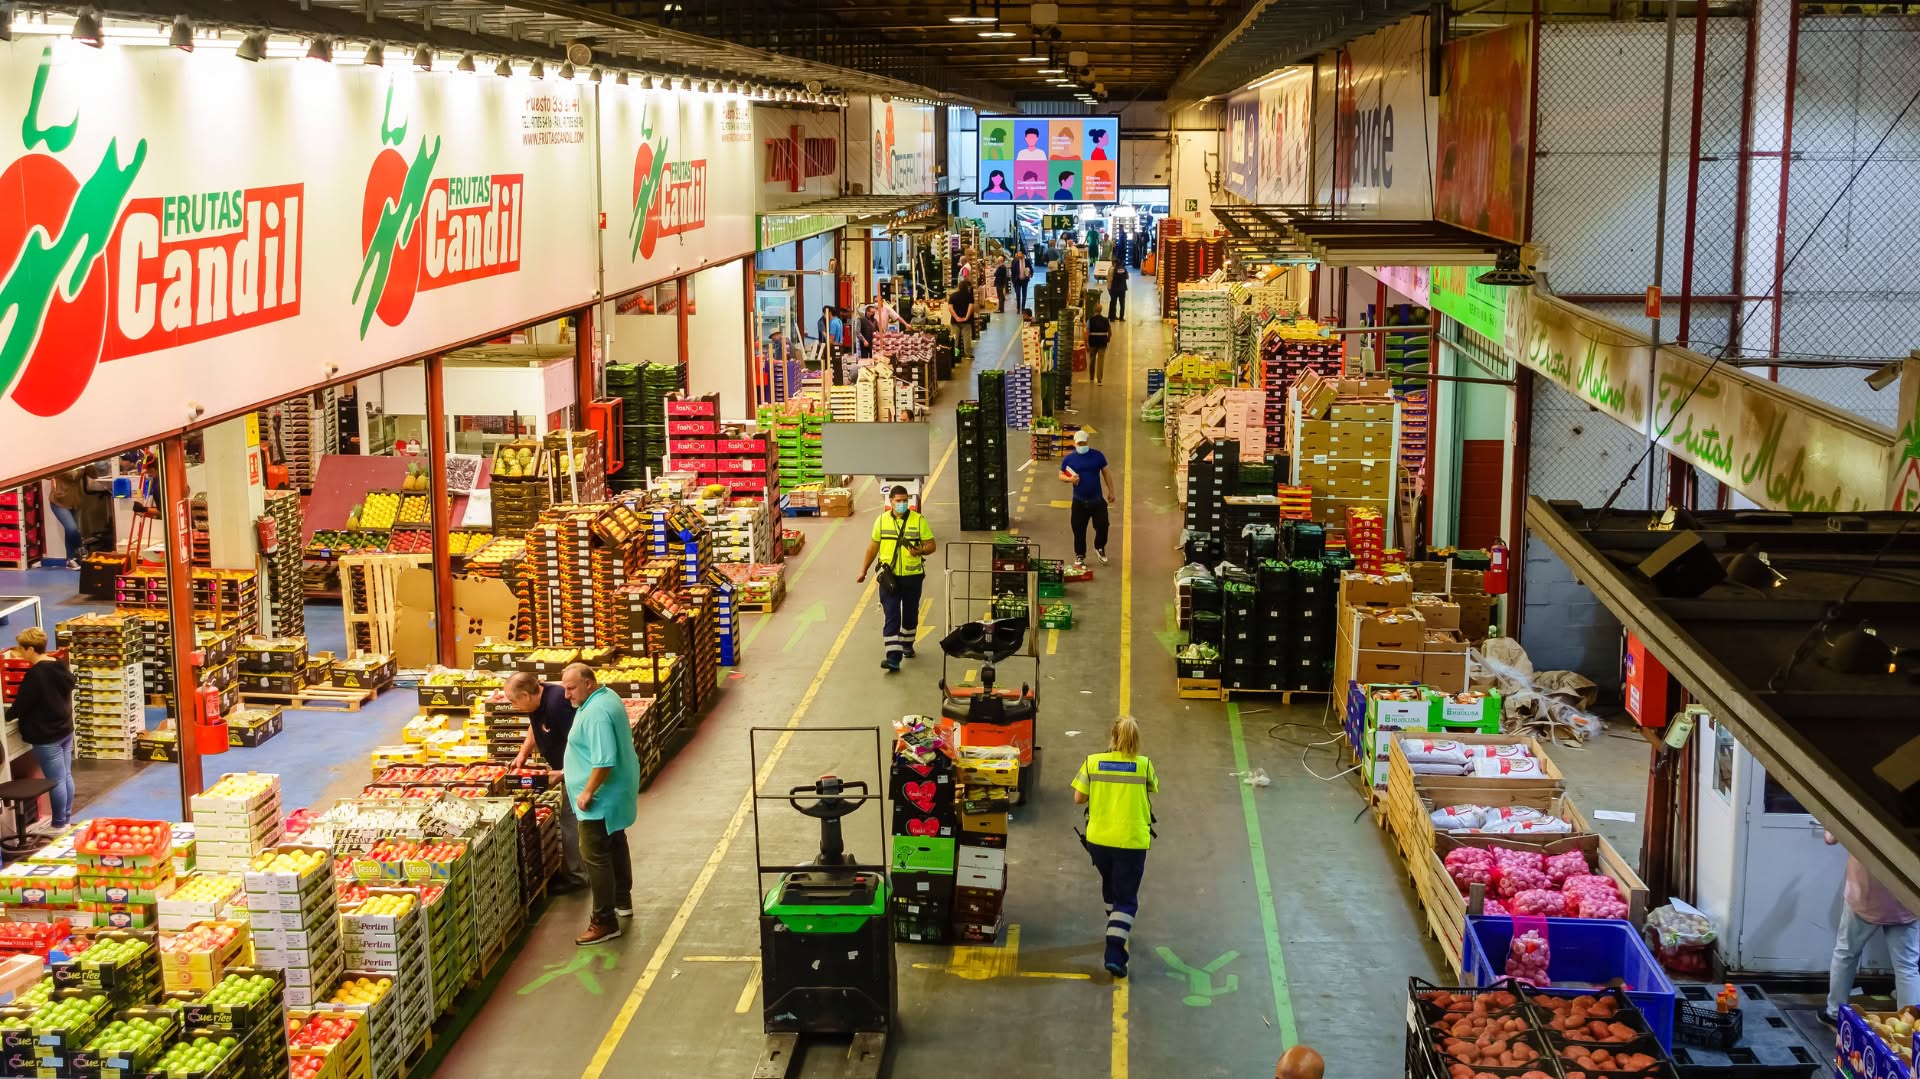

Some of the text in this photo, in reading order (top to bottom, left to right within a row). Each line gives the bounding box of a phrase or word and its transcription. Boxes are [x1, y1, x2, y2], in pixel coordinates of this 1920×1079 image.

[671, 162, 691, 181] FRUTAS
[448, 176, 490, 206] FRUTAS
[661, 166, 705, 230] Candil
[164, 190, 244, 237] FRUTAS
[426, 184, 520, 278] Candil
[118, 196, 298, 340] Candil
[1530, 320, 1572, 386] Frutas
[1576, 334, 1626, 414] Molinos
[1655, 373, 1734, 474] Frutas
[358, 863, 378, 873] Tessa
[408, 863, 428, 873] Tessa
[361, 922, 388, 931] Perlim
[363, 940, 390, 948] Perlim
[364, 958, 392, 967] Perlim
